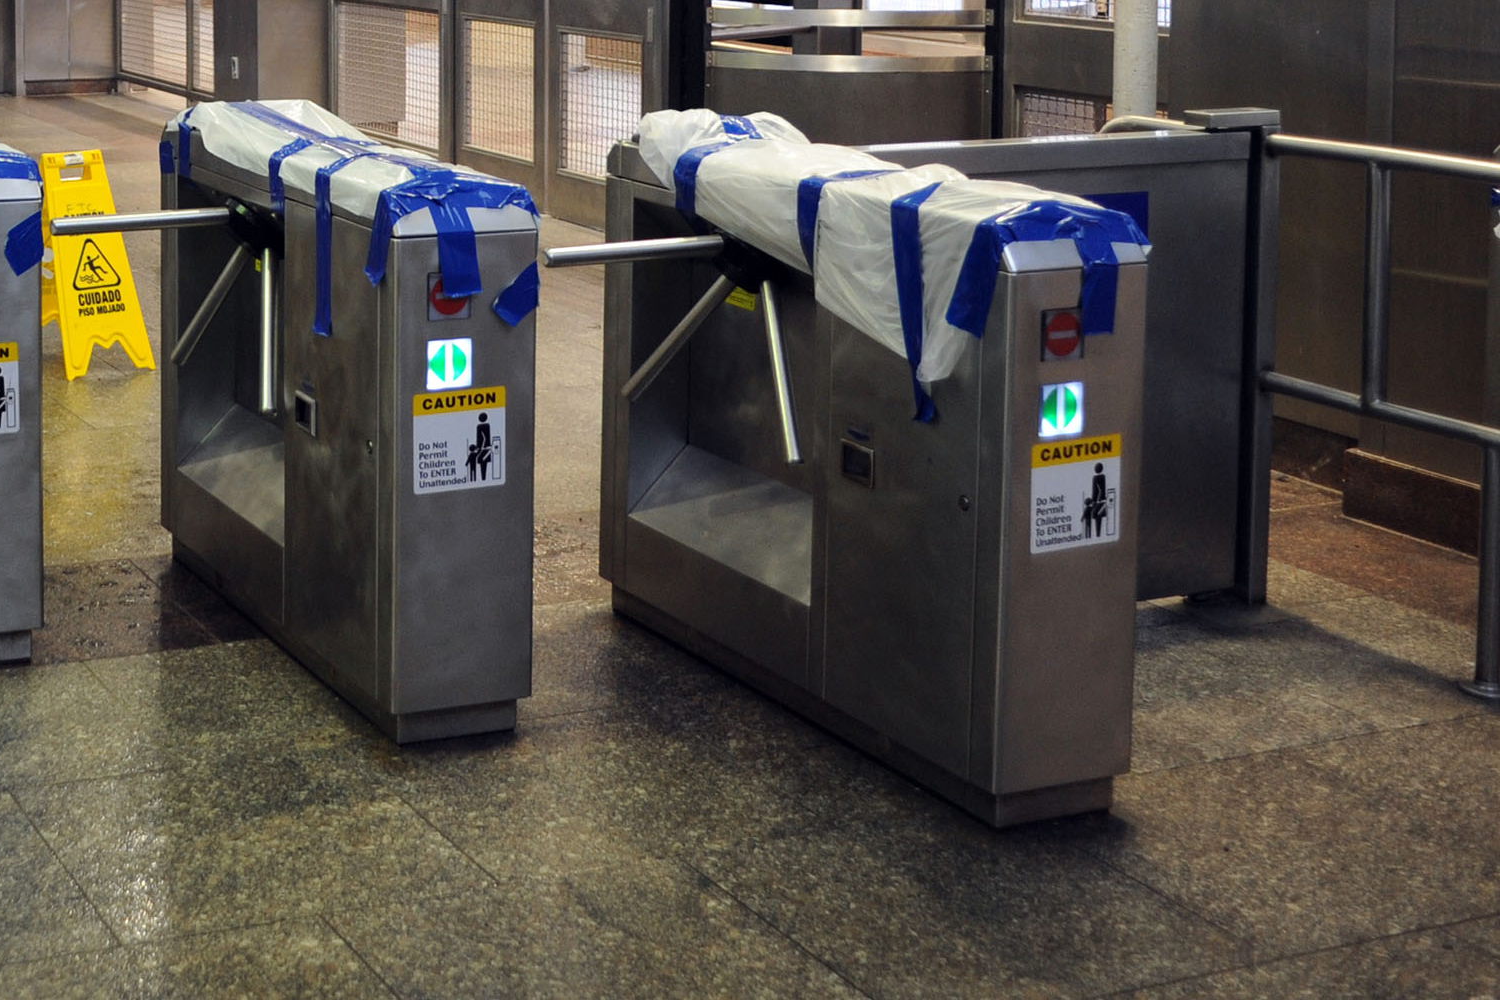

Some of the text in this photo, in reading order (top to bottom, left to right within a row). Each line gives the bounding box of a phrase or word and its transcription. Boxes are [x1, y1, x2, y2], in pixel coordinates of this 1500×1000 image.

[78, 289, 122, 307] CUIDADO
[78, 303, 126, 317] PISO MOJADO
[422, 392, 496, 410] CAUTION
[418, 441, 448, 451] Do Not
[1040, 440, 1112, 461] CAUTION
[418, 450, 448, 460] Permit
[418, 460, 456, 470] Children
[419, 468, 456, 479] To ENTER
[418, 476, 467, 489] Unattended
[1035, 494, 1064, 506] Do Not
[1035, 505, 1064, 516] Permit
[1035, 515, 1072, 527] Children
[1036, 524, 1072, 537] To ENTER
[1035, 533, 1082, 548] Unattended
